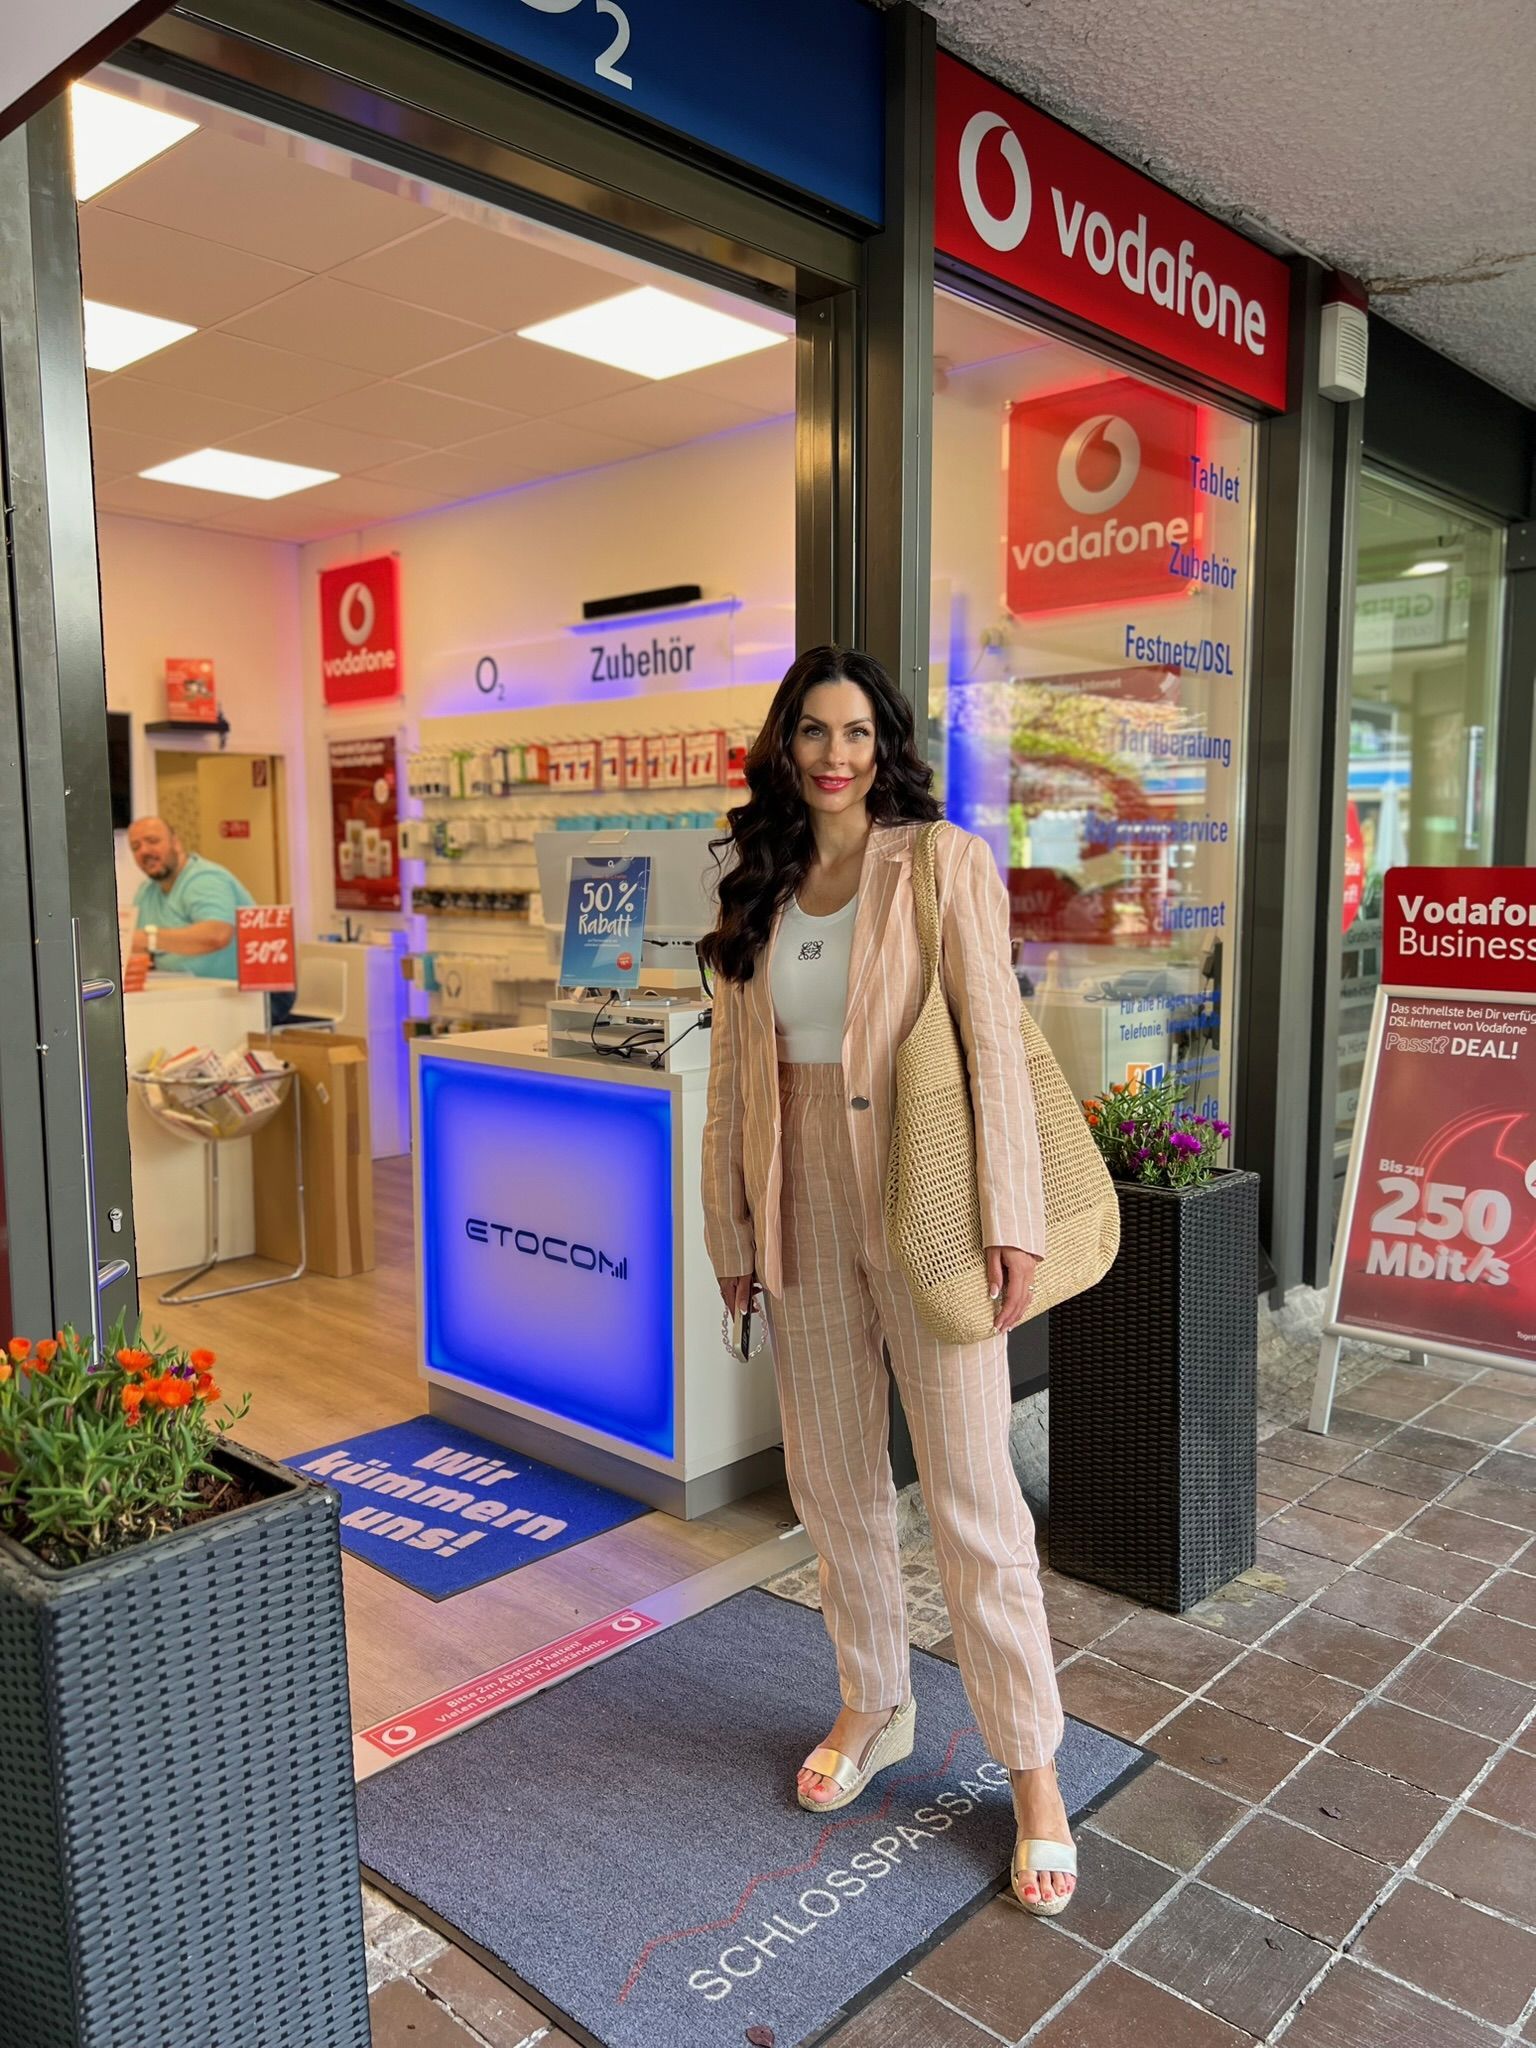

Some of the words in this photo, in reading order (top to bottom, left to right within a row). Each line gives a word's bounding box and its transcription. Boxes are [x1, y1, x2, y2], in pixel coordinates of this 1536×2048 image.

[1051, 187, 1267, 356] vodafone
[1190, 455, 1240, 503] Tablet
[1012, 514, 1190, 571] vodafone
[1169, 542, 1237, 590] Zubehör
[323, 648, 396, 678] vodafone
[590, 635, 697, 683] Zubehör
[1125, 624, 1233, 676] Festnetz/DSL
[239, 907, 290, 929] SALE
[578, 913, 633, 937] Rabatt
[1163, 900, 1225, 931] Internet
[1399, 926, 1536, 962] Business
[1120, 1020, 1163, 1041] Telefonie,
[1389, 1016, 1451, 1031] DSL-Internet
[1453, 1021, 1473, 1031] von
[1476, 1021, 1528, 1036] Vodafone
[1391, 1003, 1410, 1014] Das
[1411, 1005, 1464, 1018] schnellste
[1466, 1008, 1482, 1019] bei
[1485, 1008, 1500, 1020] Dir
[1385, 1032, 1449, 1054] Passt?
[1451, 1037, 1519, 1060] DEAL!
[1379, 1158, 1403, 1174] Bis
[1404, 1165, 1424, 1177] zu
[1370, 1176, 1512, 1246] 250
[465, 1218, 628, 1281] ETOCOM
[1365, 1239, 1510, 1287] Mbit/s
[412, 1446, 520, 1487] Wir
[299, 1450, 568, 1542] kümmern
[340, 1506, 488, 1558] uns!
[435, 1702, 478, 1724] Vielen
[476, 1687, 508, 1704] Dank
[506, 1678, 525, 1690] für
[525, 1670, 542, 1681] Ihr
[542, 1639, 609, 1673] Verständnis.
[446, 1690, 478, 1709] Bitte
[477, 1681, 498, 1695] 2m
[498, 1659, 544, 1685] Abstand
[542, 1640, 583, 1661] halten!
[688, 1761, 1009, 2002] SCHLOSSPASSAG
